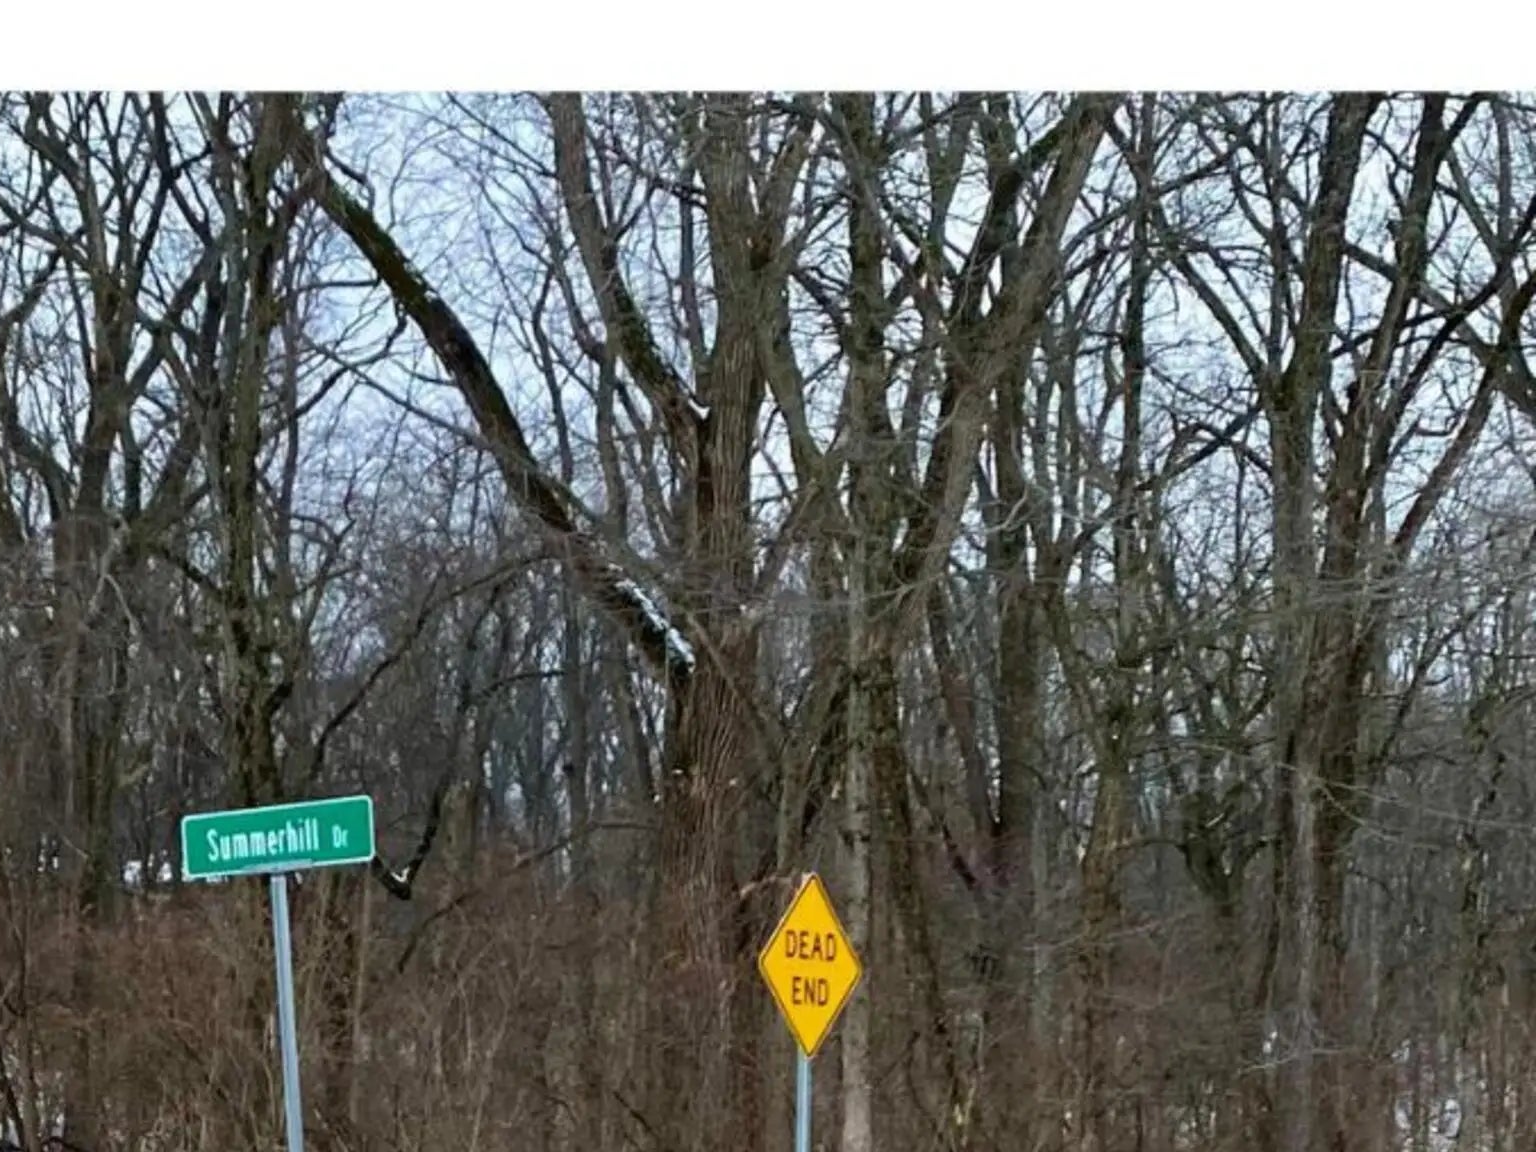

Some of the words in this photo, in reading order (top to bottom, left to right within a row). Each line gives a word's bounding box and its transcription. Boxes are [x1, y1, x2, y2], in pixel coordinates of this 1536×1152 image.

[206, 817, 320, 862] Summerhill
[331, 823, 349, 849] Dr
[785, 929, 837, 962] DEAD
[791, 975, 830, 1007] END
